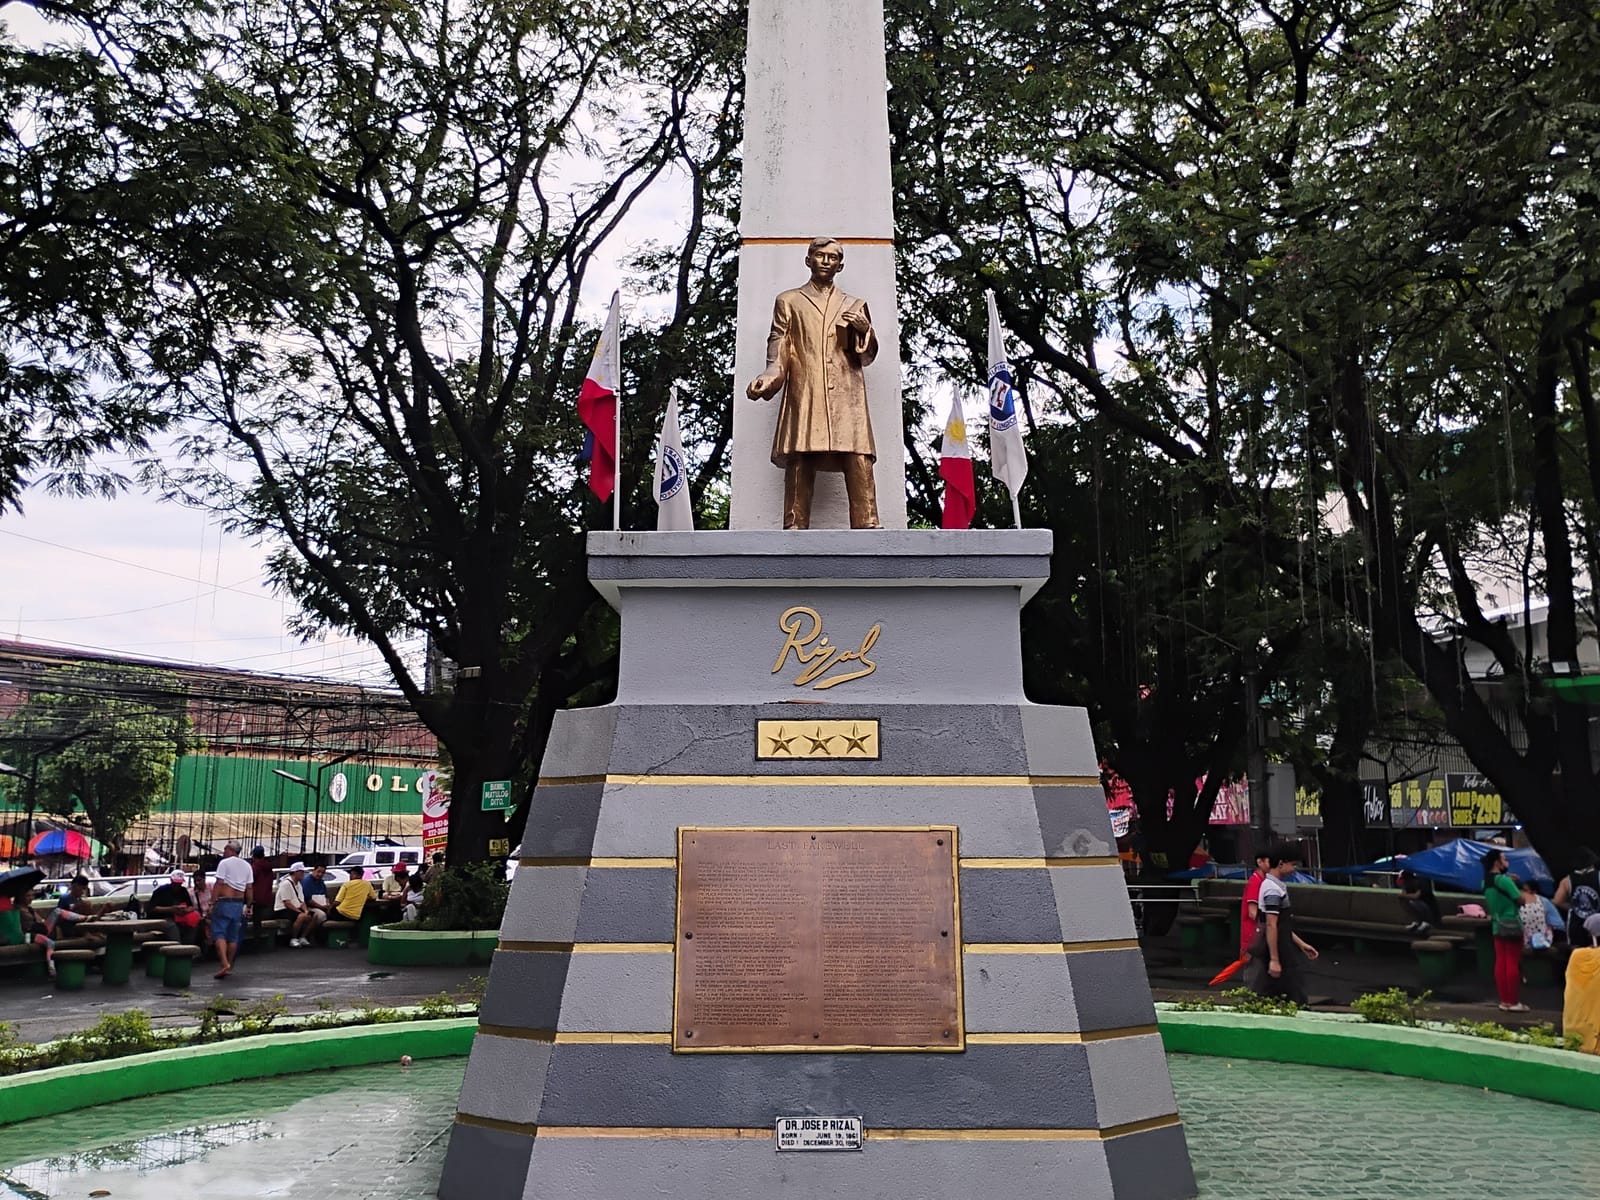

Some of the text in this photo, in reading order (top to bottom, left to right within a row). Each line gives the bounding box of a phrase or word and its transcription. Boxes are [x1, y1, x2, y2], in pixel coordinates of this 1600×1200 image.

[772, 606, 881, 690] Rizal
[485, 790, 509, 799] MATULOG
[767, 840, 865, 850] LAST FAREWELL
[785, 1120, 800, 1131] DR.
[800, 1120, 821, 1131] JOSE
[830, 1120, 855, 1131] RIZAL
